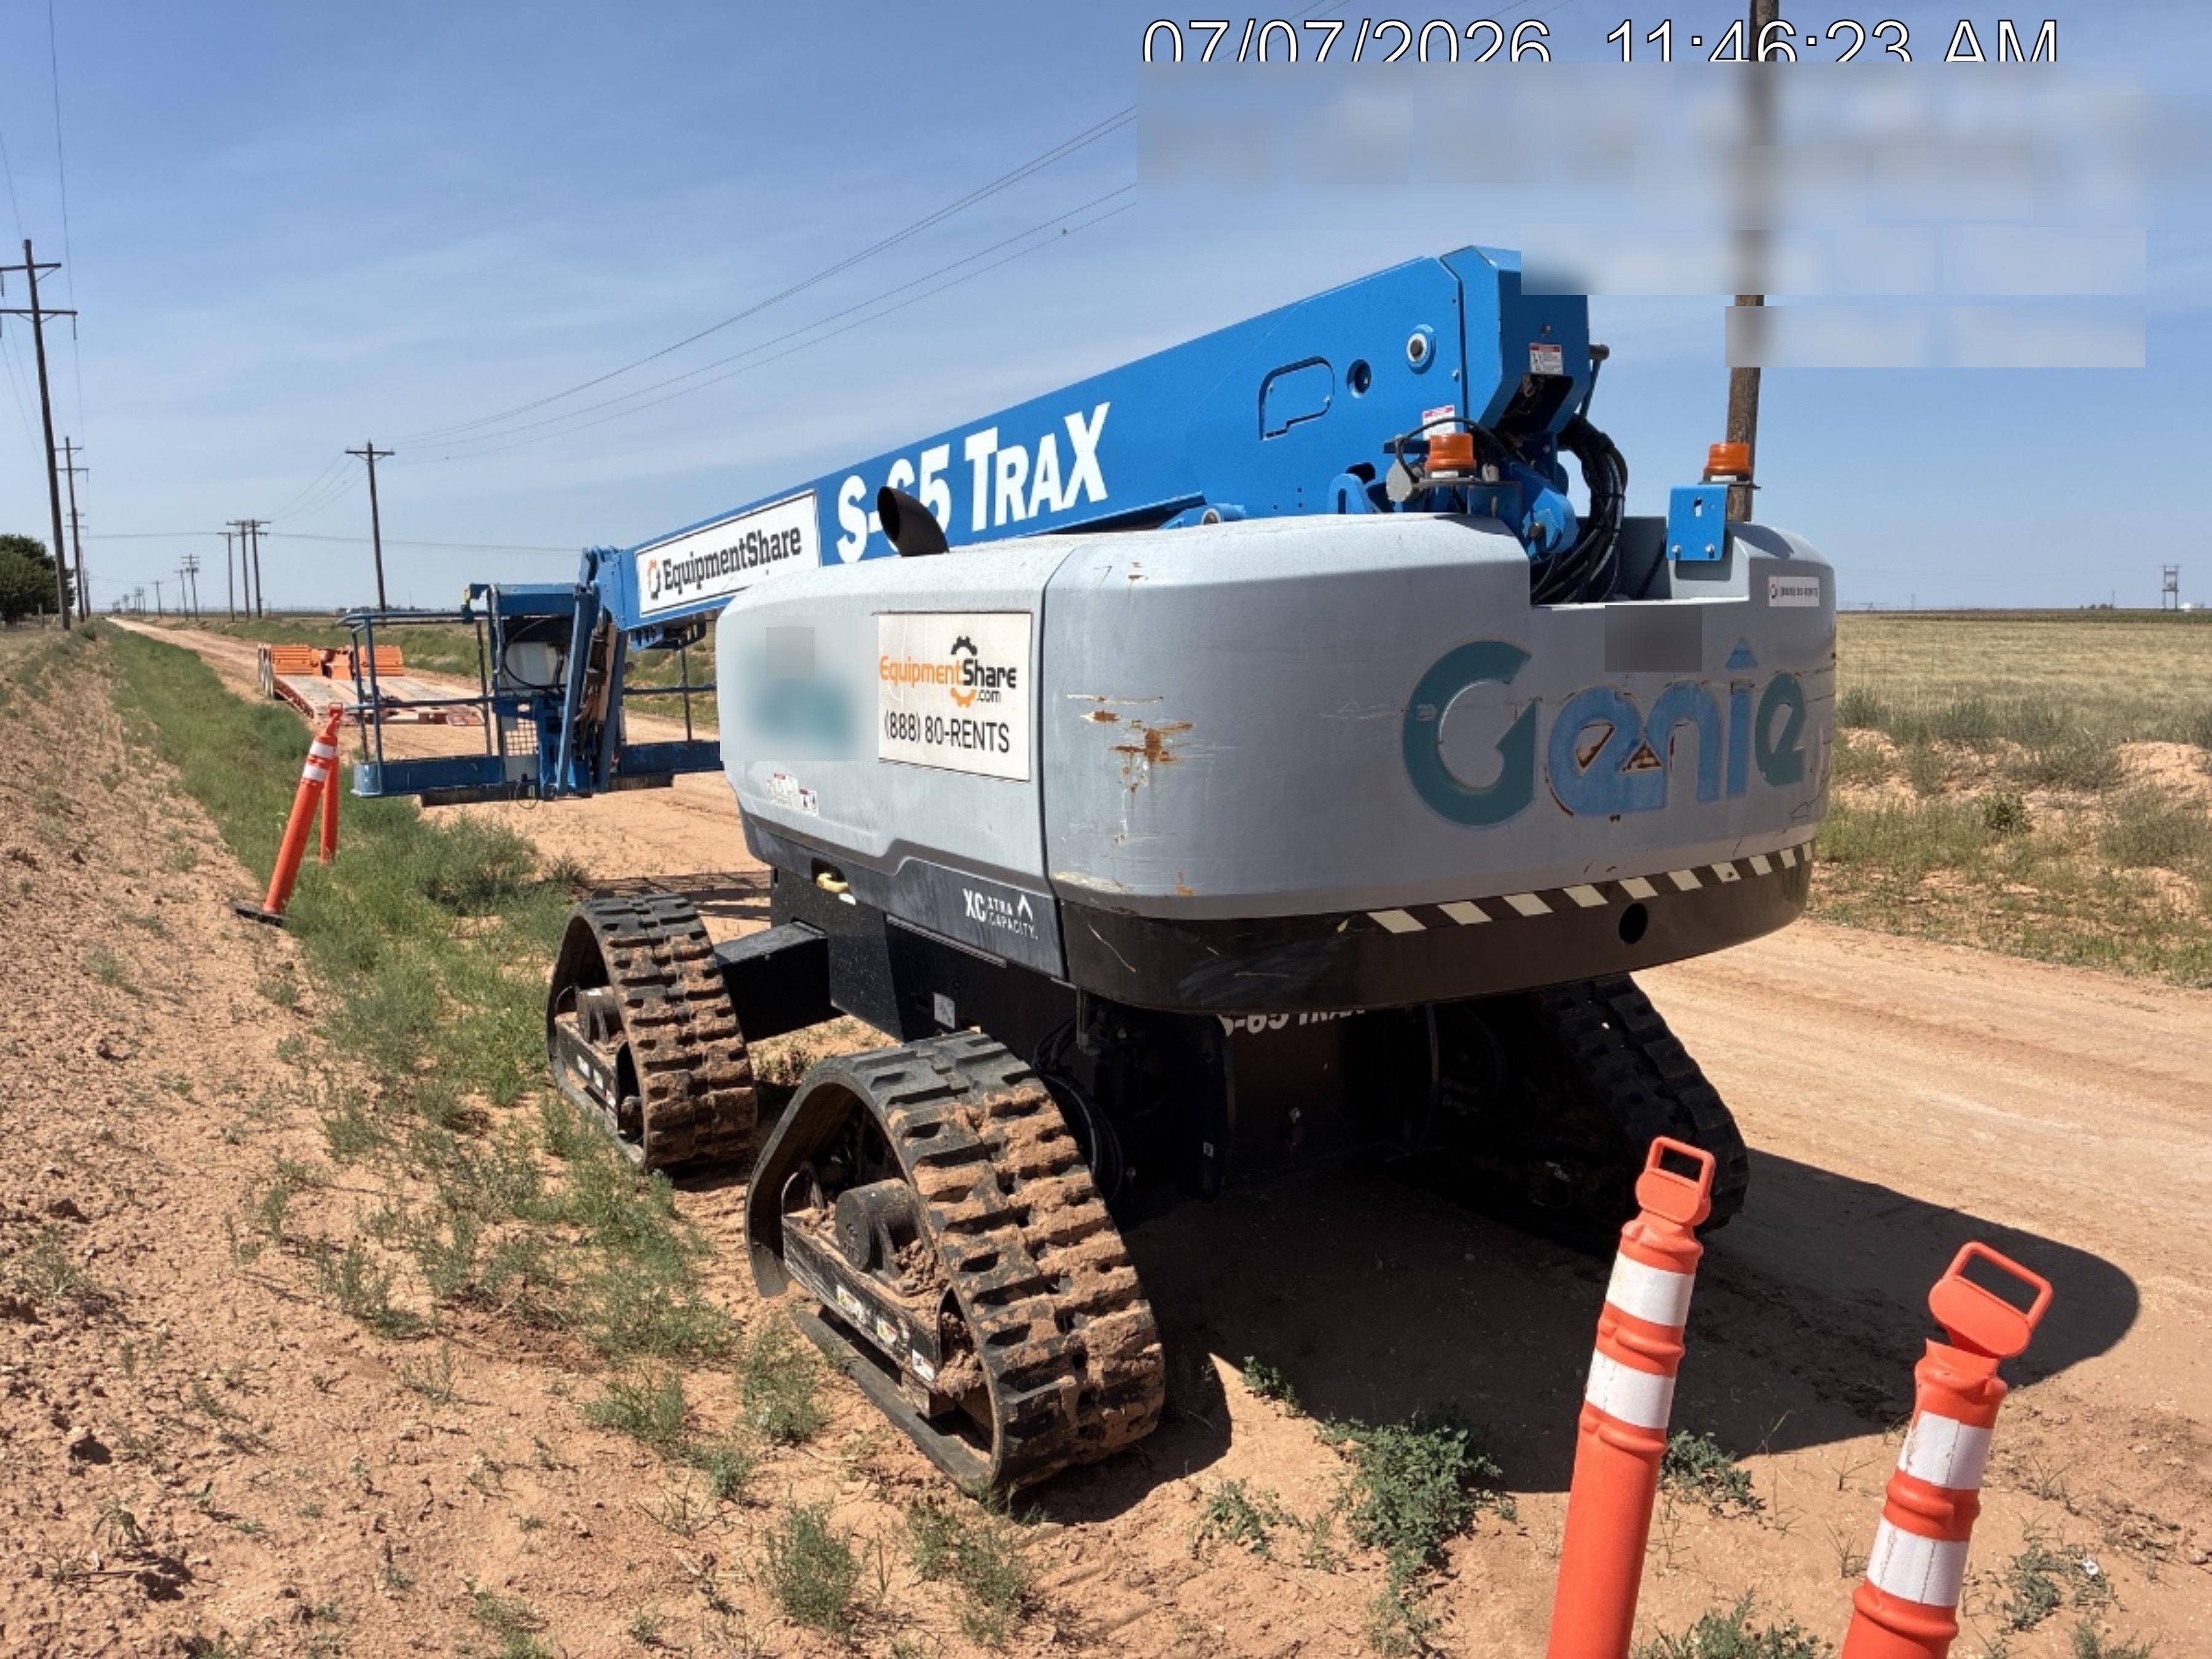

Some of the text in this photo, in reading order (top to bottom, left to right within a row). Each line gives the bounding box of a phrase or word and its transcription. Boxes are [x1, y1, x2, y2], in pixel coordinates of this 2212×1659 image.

[662, 527, 802, 595] EquipmentShare
[879, 655, 1018, 689] EquipmentShare
[976, 689, 1002, 703] .com
[884, 709, 1010, 753] (888) 80-RENTS
[1402, 636, 1805, 830] Genie
[962, 887, 987, 923] XC
